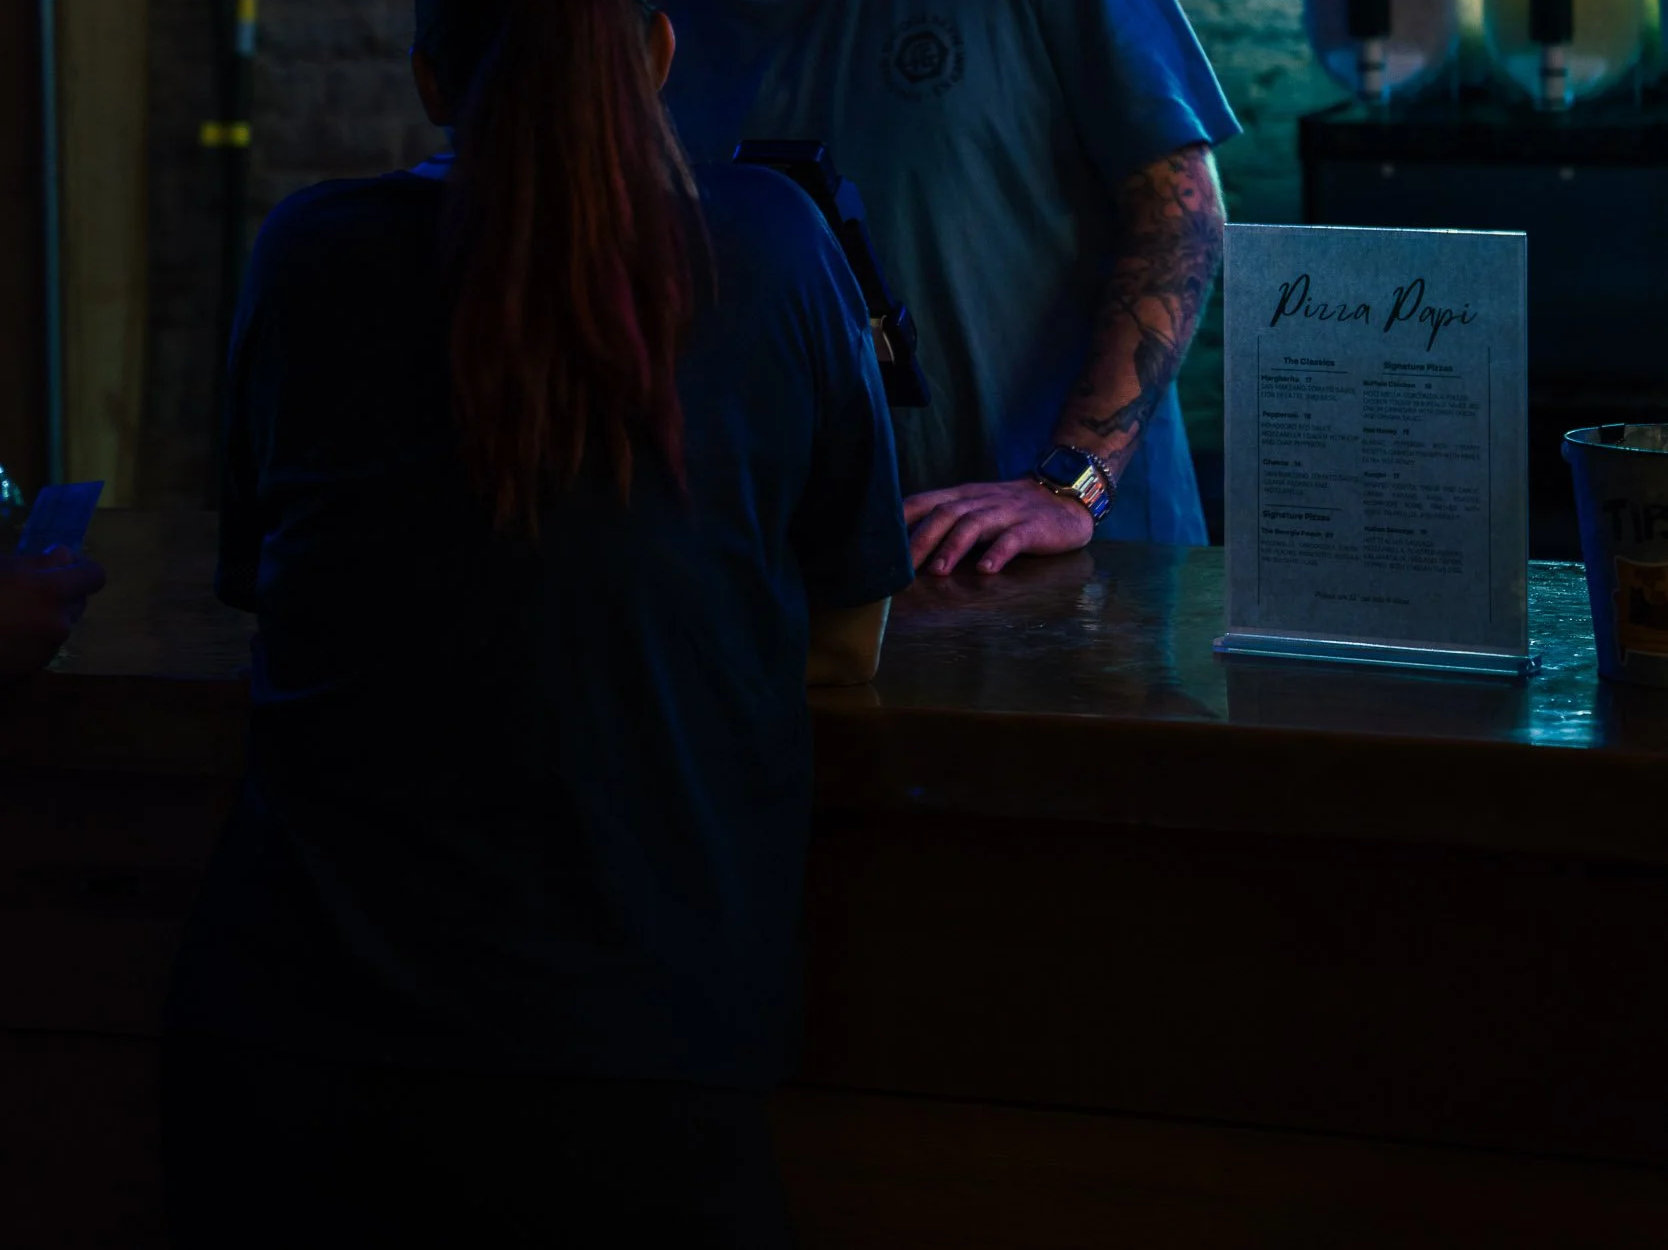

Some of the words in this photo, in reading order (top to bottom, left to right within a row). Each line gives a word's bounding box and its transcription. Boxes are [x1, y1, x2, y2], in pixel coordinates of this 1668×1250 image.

[1269, 274, 1370, 327] Pizza
[1383, 278, 1477, 352] Papi
[1284, 356, 1299, 365] The
[1300, 358, 1335, 366] Classics
[1383, 361, 1425, 371] Signature
[1426, 363, 1454, 372] Pizzas
[1263, 510, 1303, 520] Signature
[1304, 513, 1330, 521] Pizzas
[1602, 498, 1668, 543] TIP
